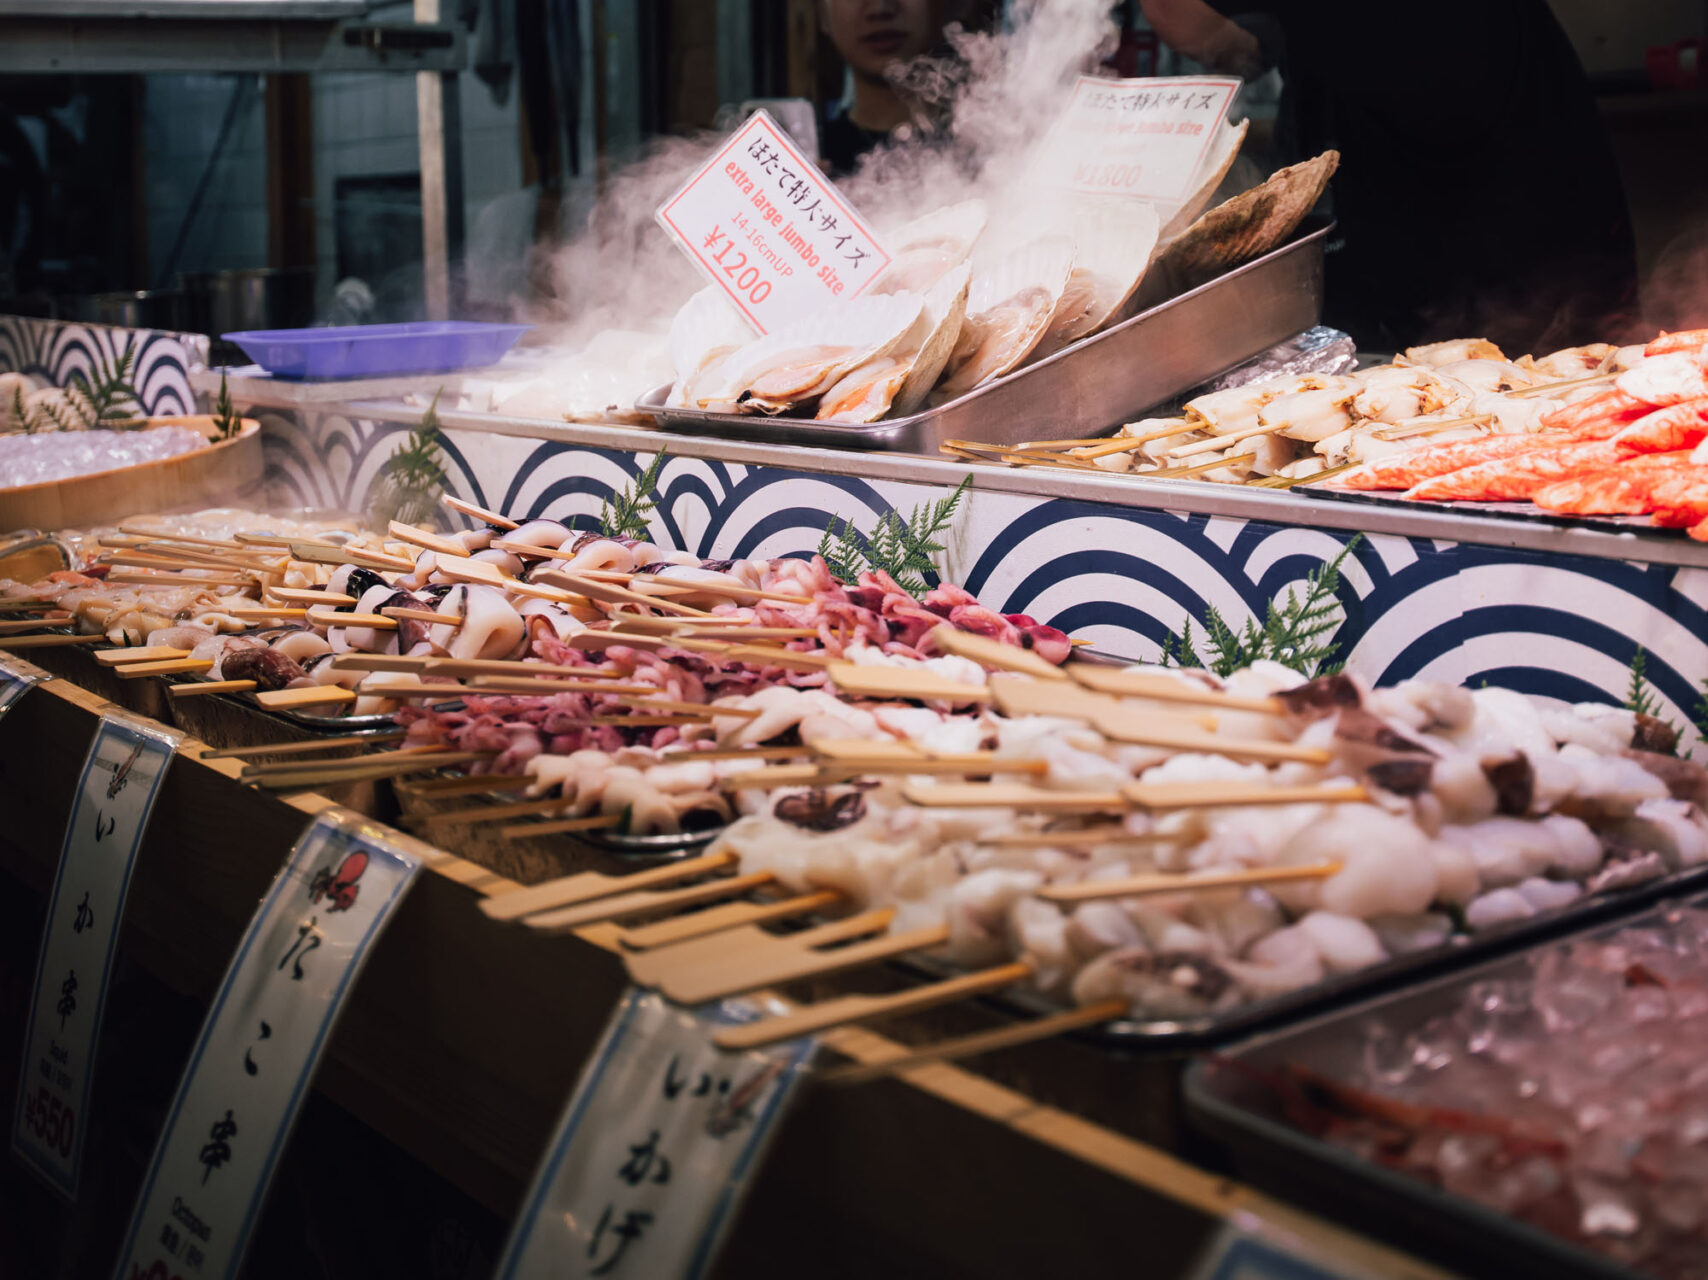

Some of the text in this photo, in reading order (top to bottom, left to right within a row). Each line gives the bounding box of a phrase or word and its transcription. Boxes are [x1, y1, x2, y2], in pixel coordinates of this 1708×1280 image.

[703, 224, 772, 305] ¥1200
[724, 161, 845, 295] extra large jumbo size
[731, 211, 793, 278] 14-16cmUP
[747, 137, 871, 269] ほたて特大サイズ
[55, 808, 116, 1032] いか串
[199, 916, 321, 1187] たこ串
